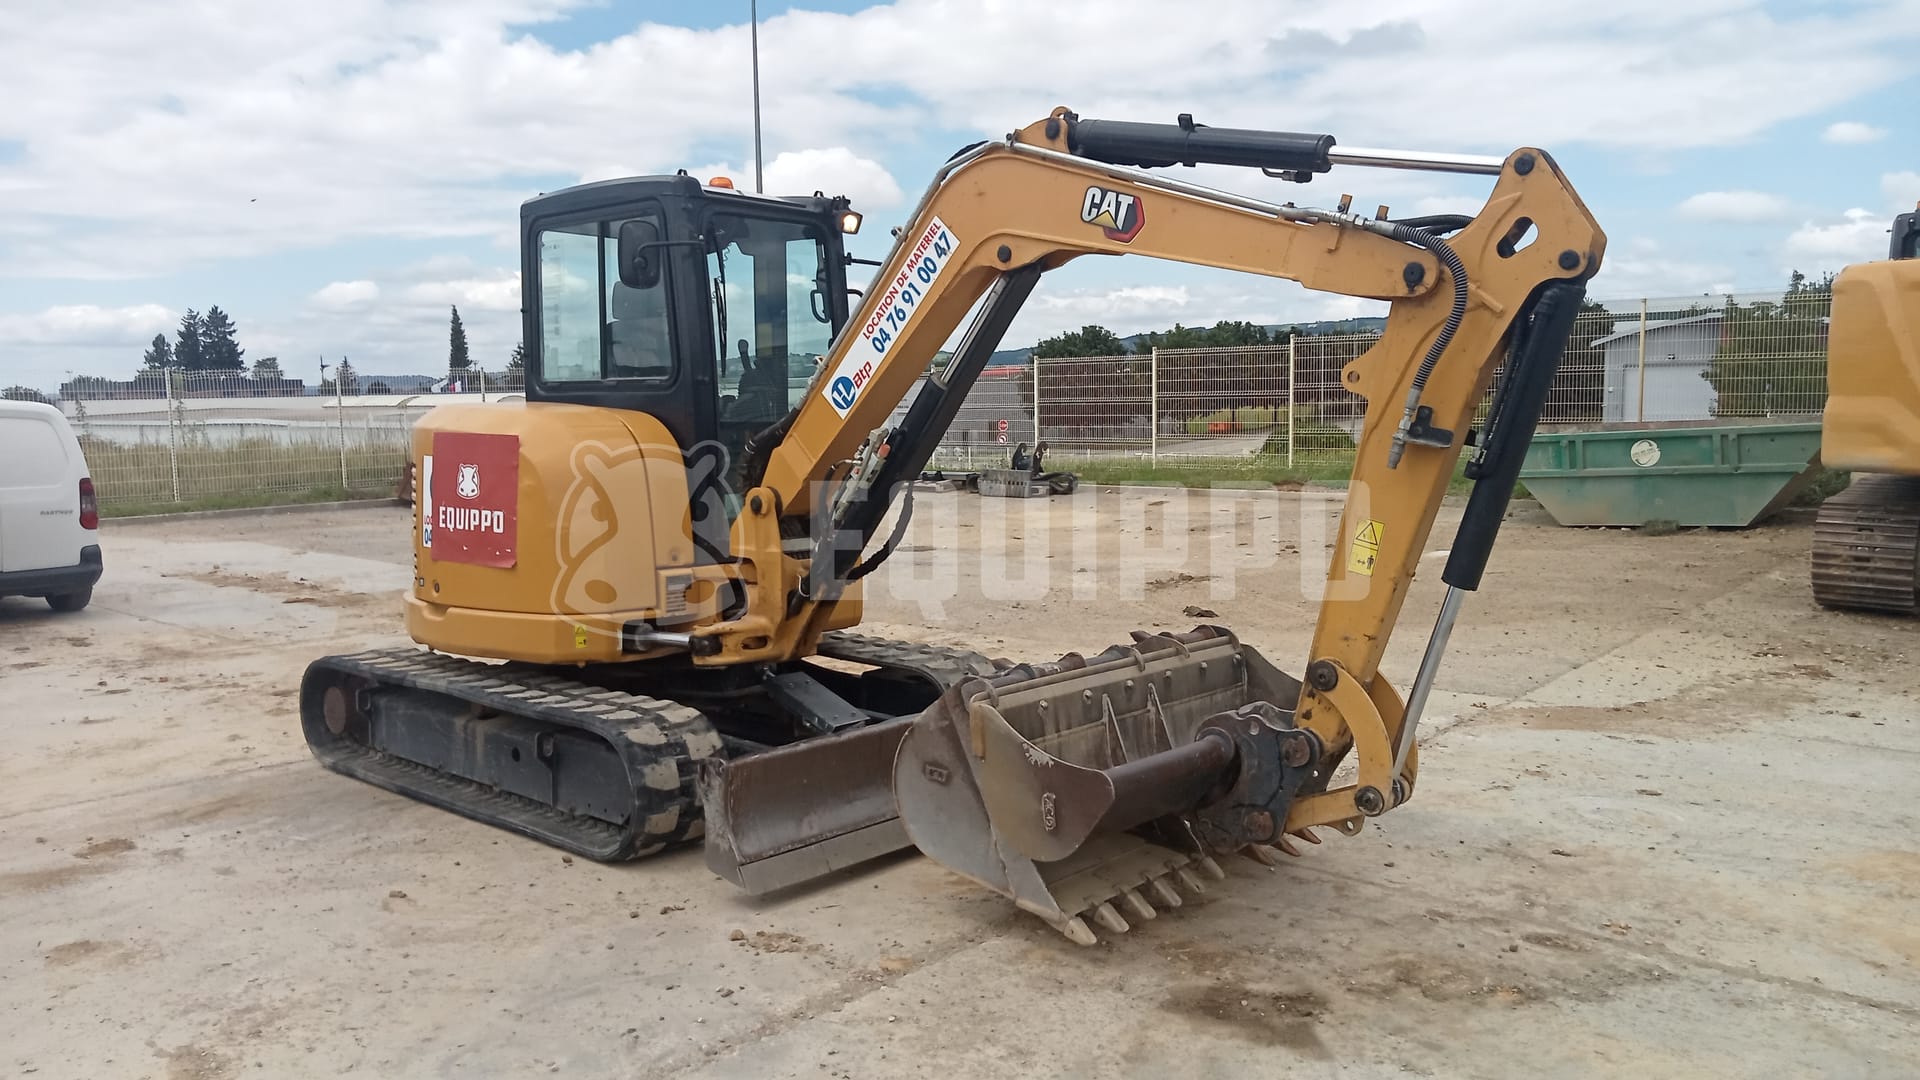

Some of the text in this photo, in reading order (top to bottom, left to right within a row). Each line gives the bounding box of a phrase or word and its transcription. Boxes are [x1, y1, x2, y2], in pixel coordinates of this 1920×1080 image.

[1081, 186, 1135, 231] CAT
[862, 222, 942, 340] LOCATION DE MATERIEL
[871, 230, 952, 354] 04 76 91 00 47
[852, 360, 873, 389] Btp
[438, 505, 505, 534] EQUIPPO
